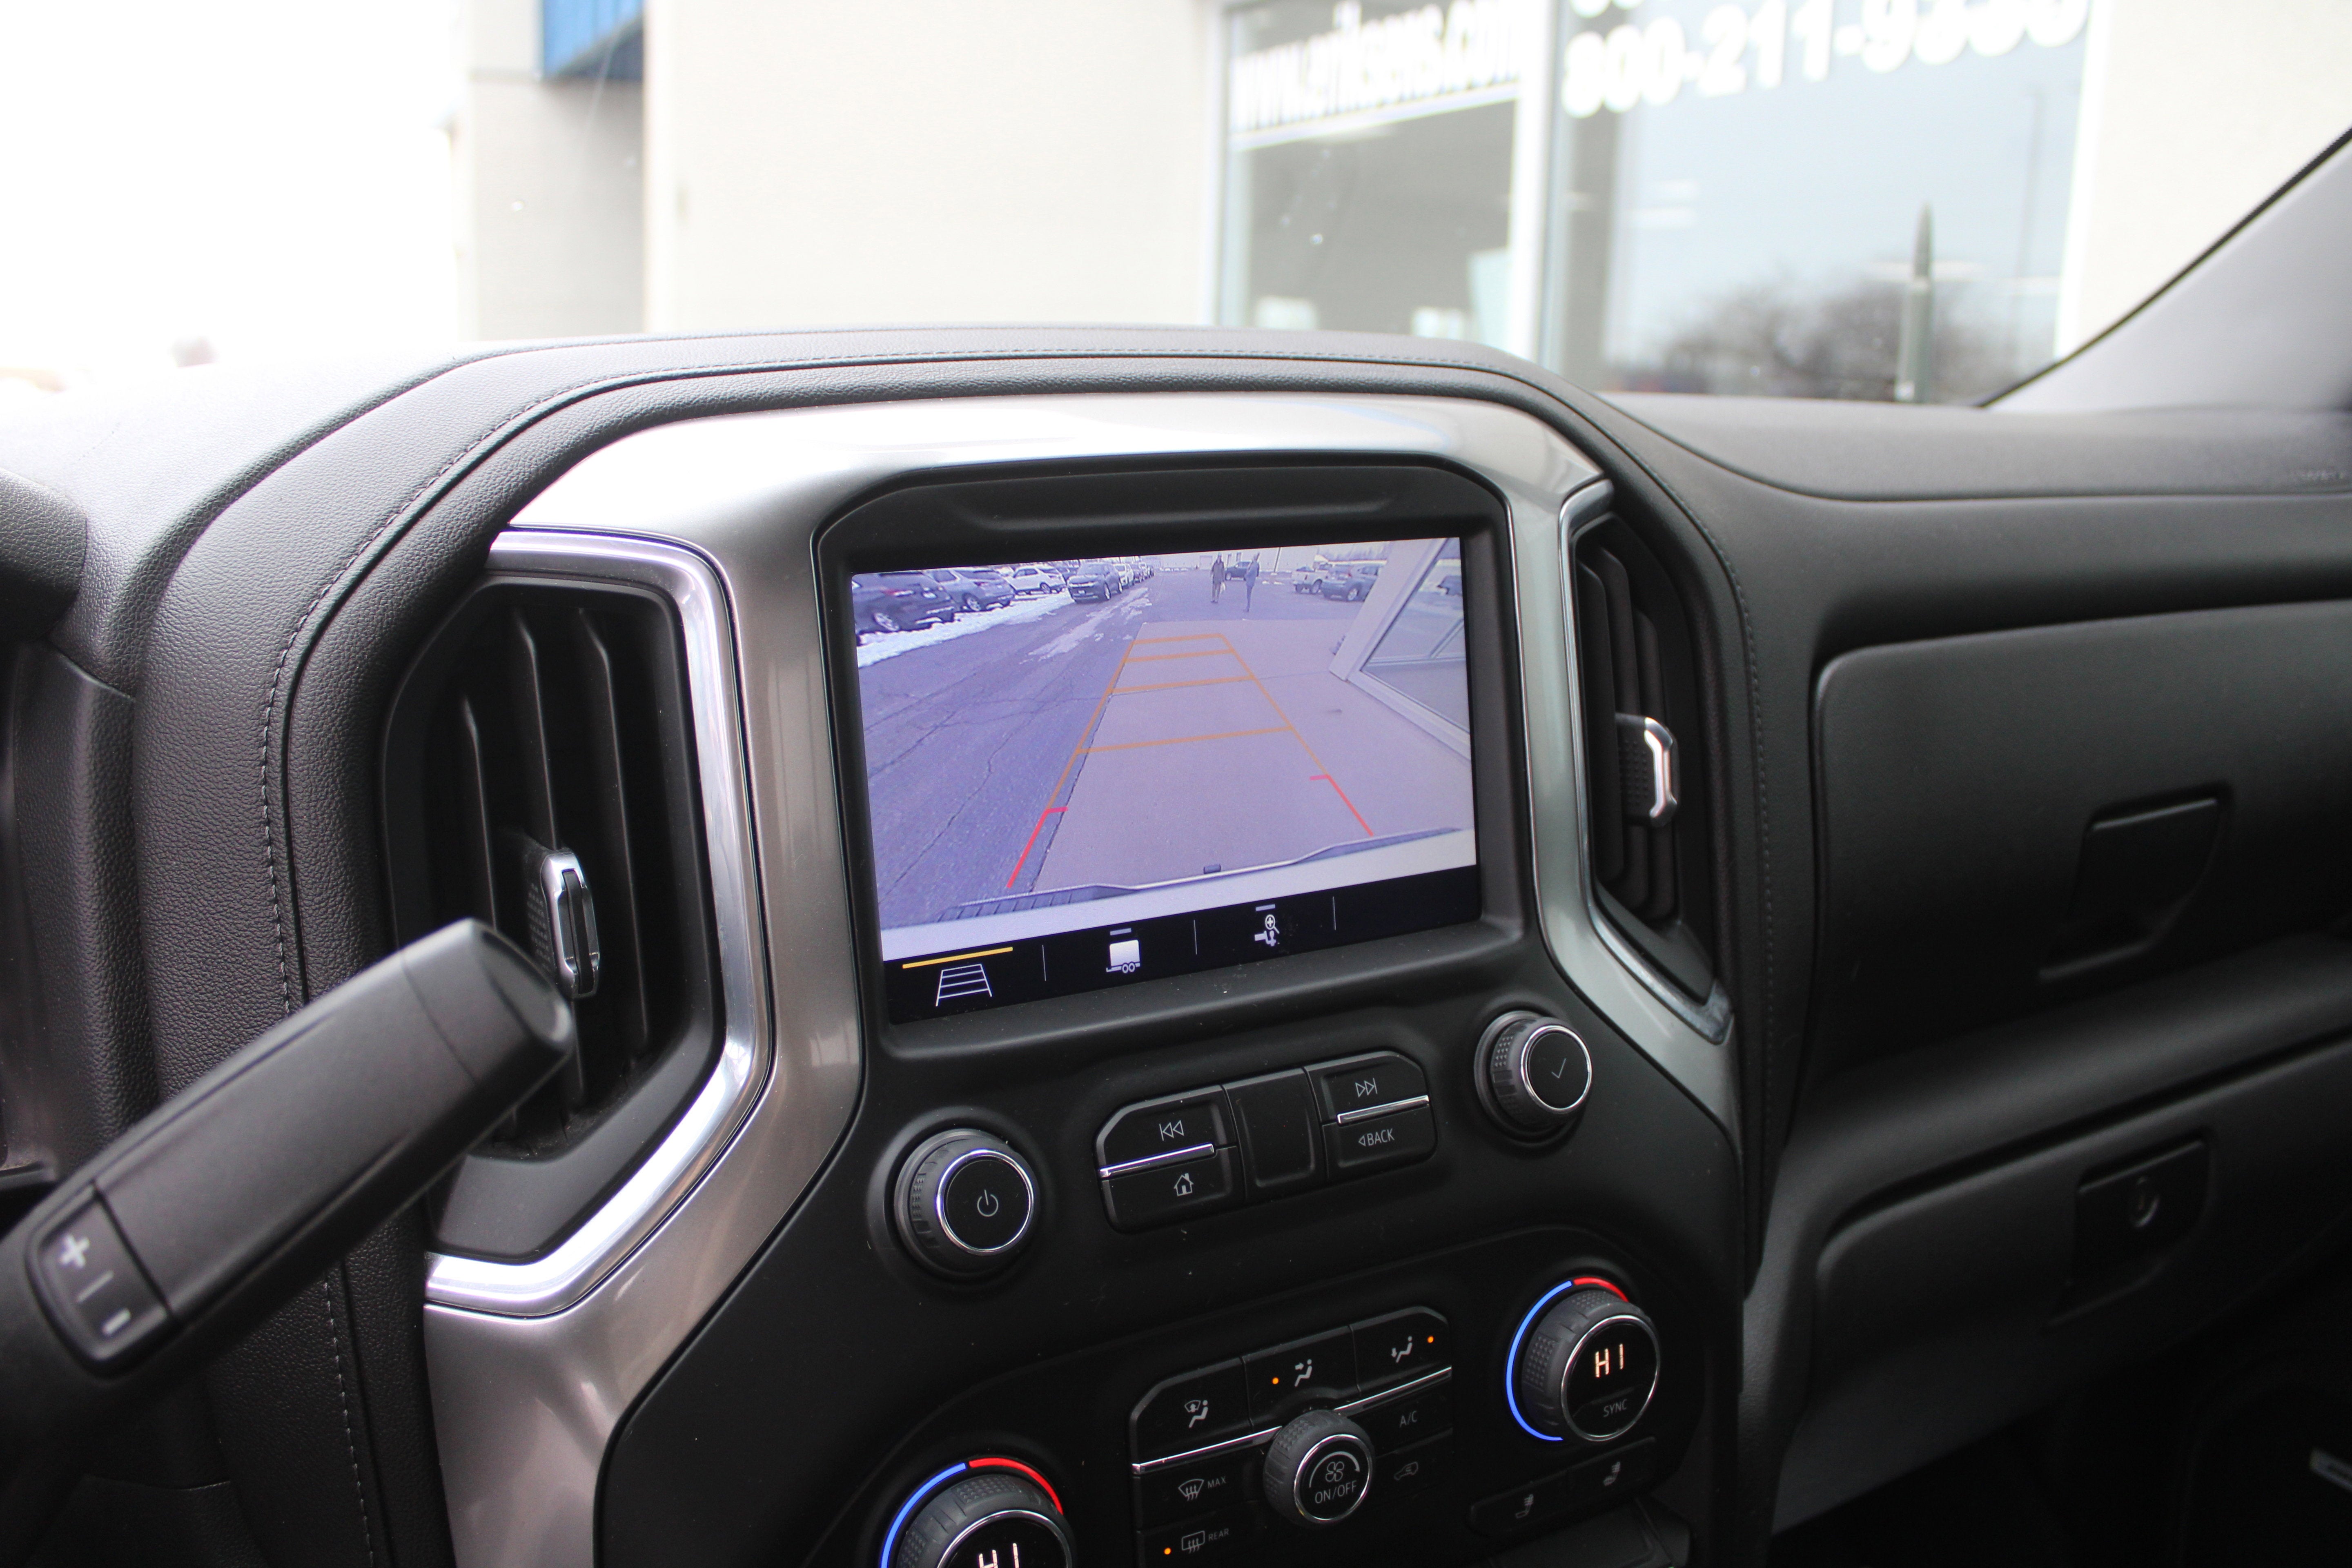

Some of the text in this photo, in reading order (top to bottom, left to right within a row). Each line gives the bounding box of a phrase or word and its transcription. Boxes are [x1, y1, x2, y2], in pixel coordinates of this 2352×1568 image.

[1367, 1128, 1395, 1146] BACK
[1595, 1343, 1624, 1378] HI
[1603, 1399, 1627, 1417] SYNC
[1400, 1411, 1417, 1428] A/C
[1207, 1476, 1226, 1488] MAX
[1315, 1480, 1357, 1503] ON/OFF
[1208, 1528, 1229, 1541] REAR
